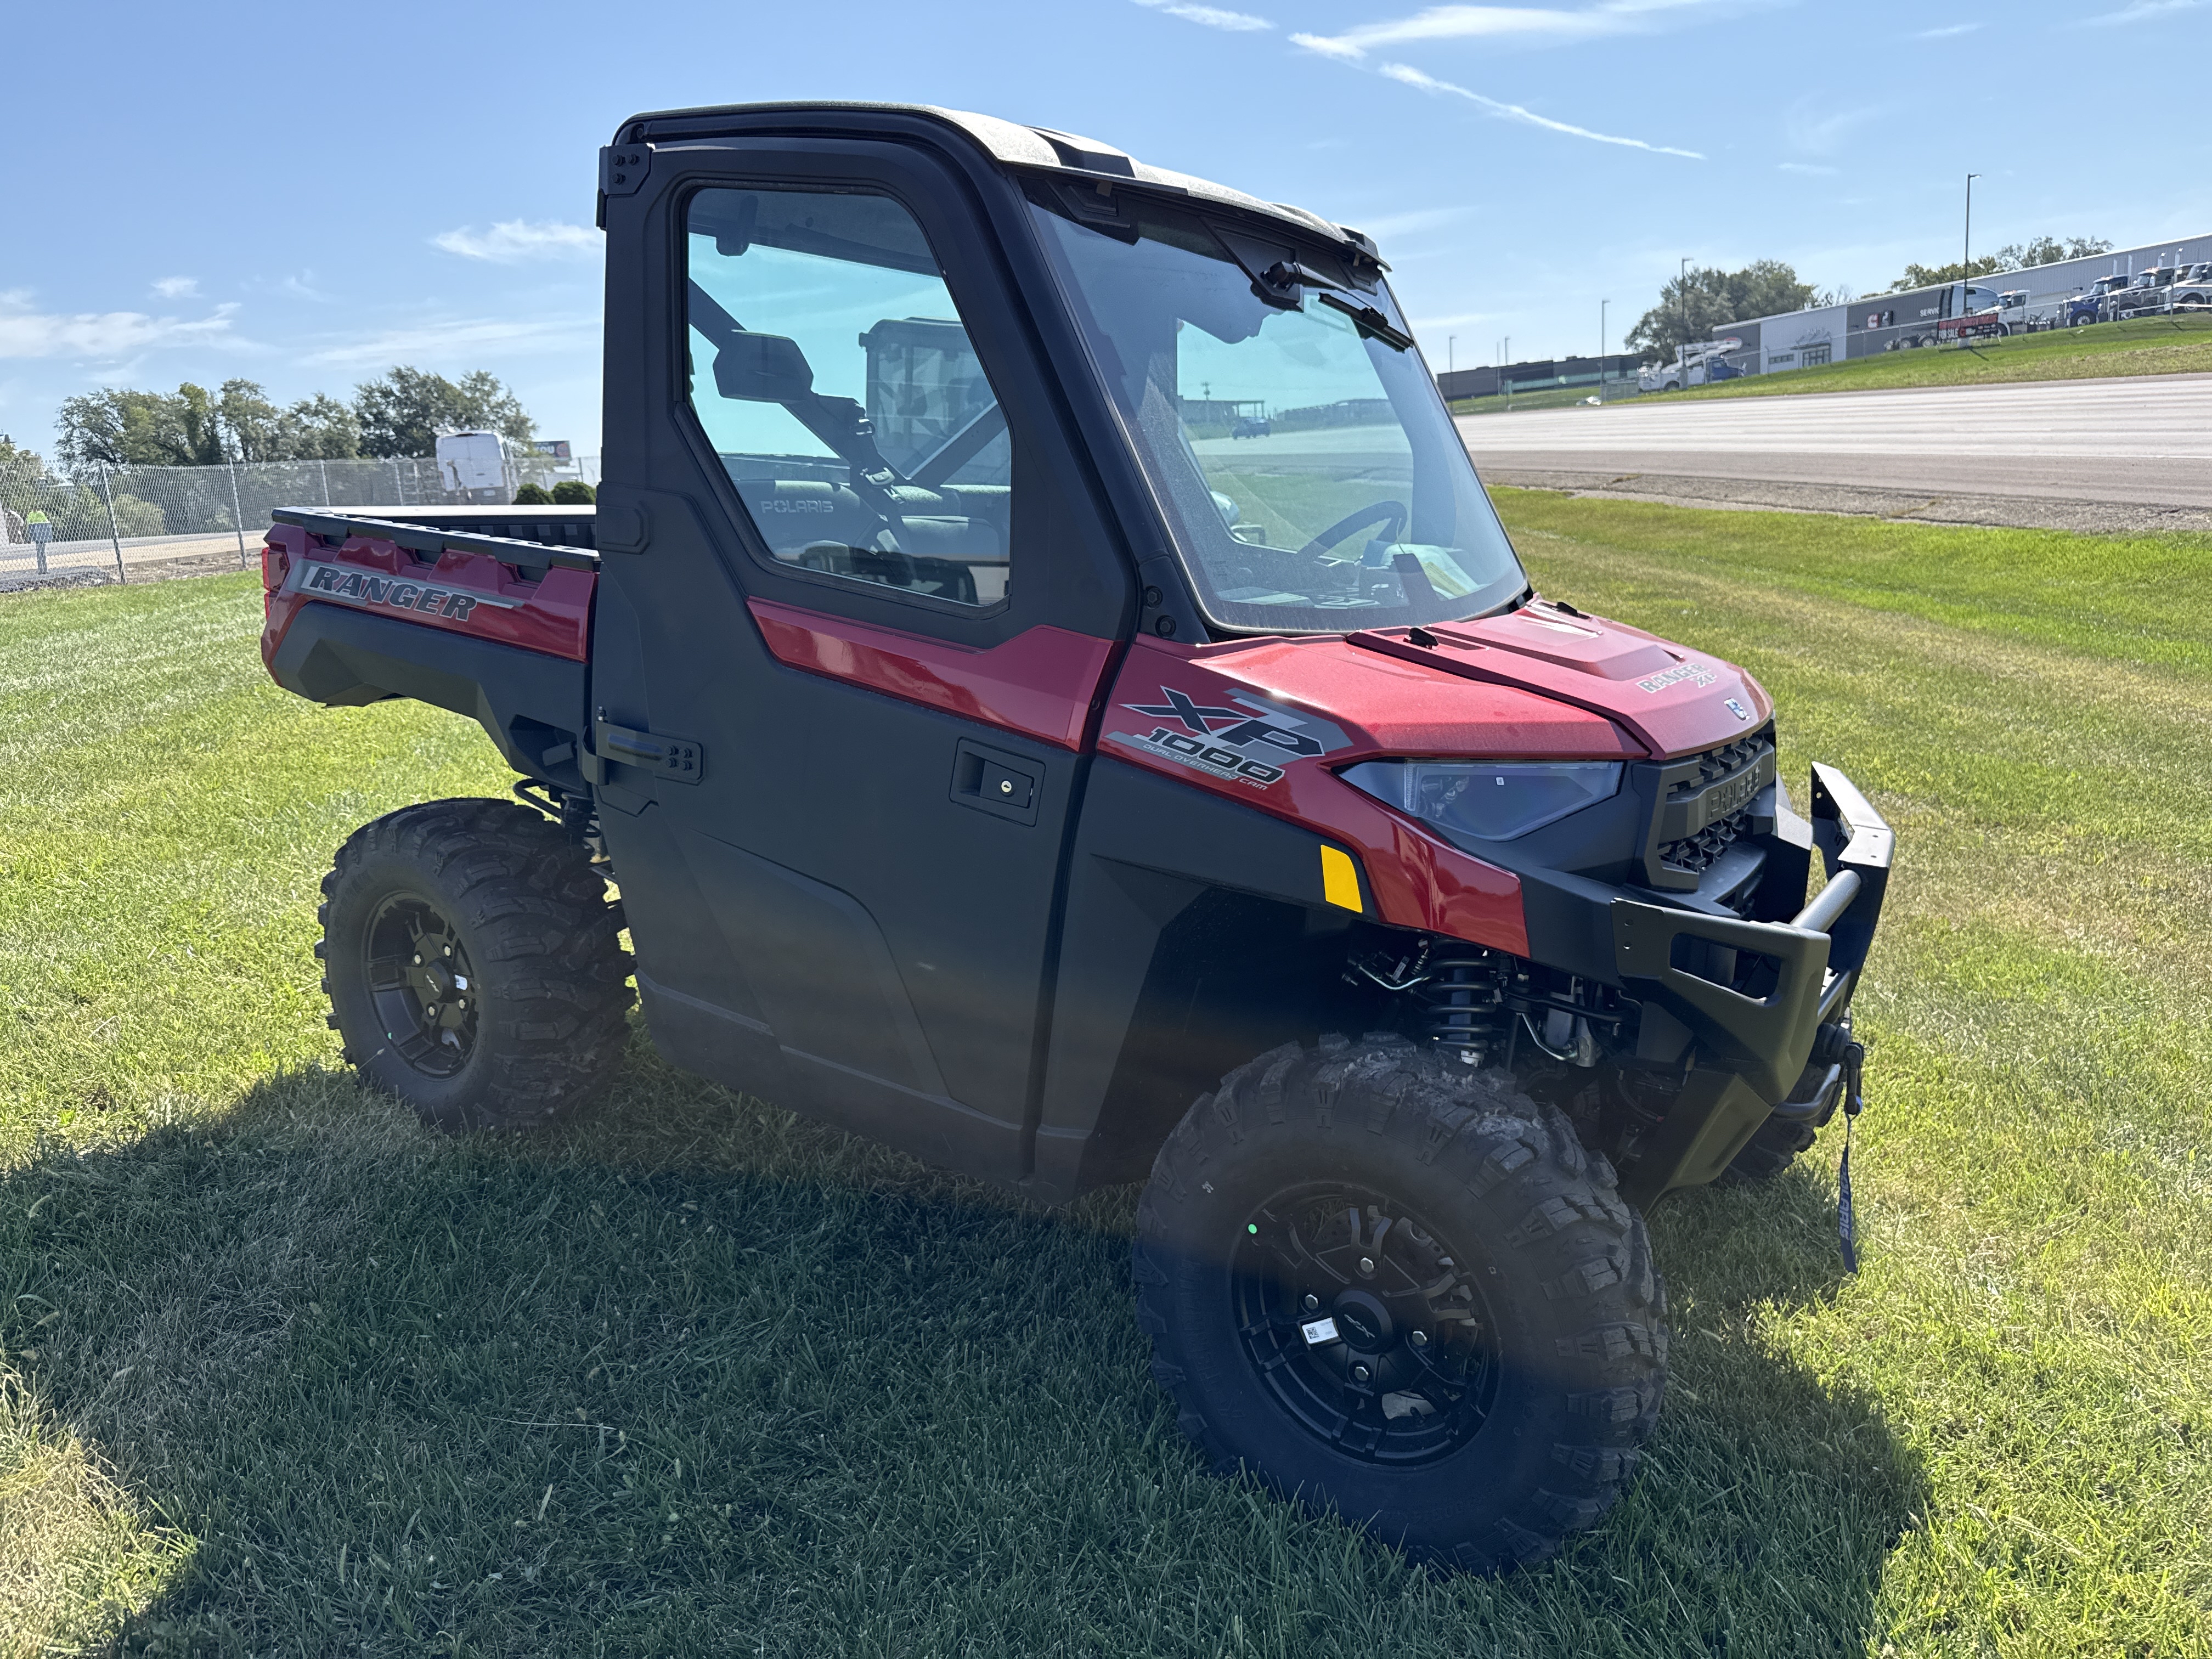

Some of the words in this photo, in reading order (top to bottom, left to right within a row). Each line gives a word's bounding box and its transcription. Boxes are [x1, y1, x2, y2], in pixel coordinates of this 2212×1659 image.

[760, 500, 834, 514] POLARIS
[309, 566, 477, 622] RANGER
[1636, 663, 1710, 693] RANGER
[1691, 673, 1717, 688] XP
[1118, 685, 1325, 757] XP
[1142, 743, 1172, 758] DUAL
[1174, 755, 1239, 781] OVERHEAD
[1239, 776, 1268, 790] CAM
[1147, 726, 1285, 785] 1000
[1709, 765, 1761, 820] POLARIS
[1839, 1163, 1850, 1240] POLARIS
